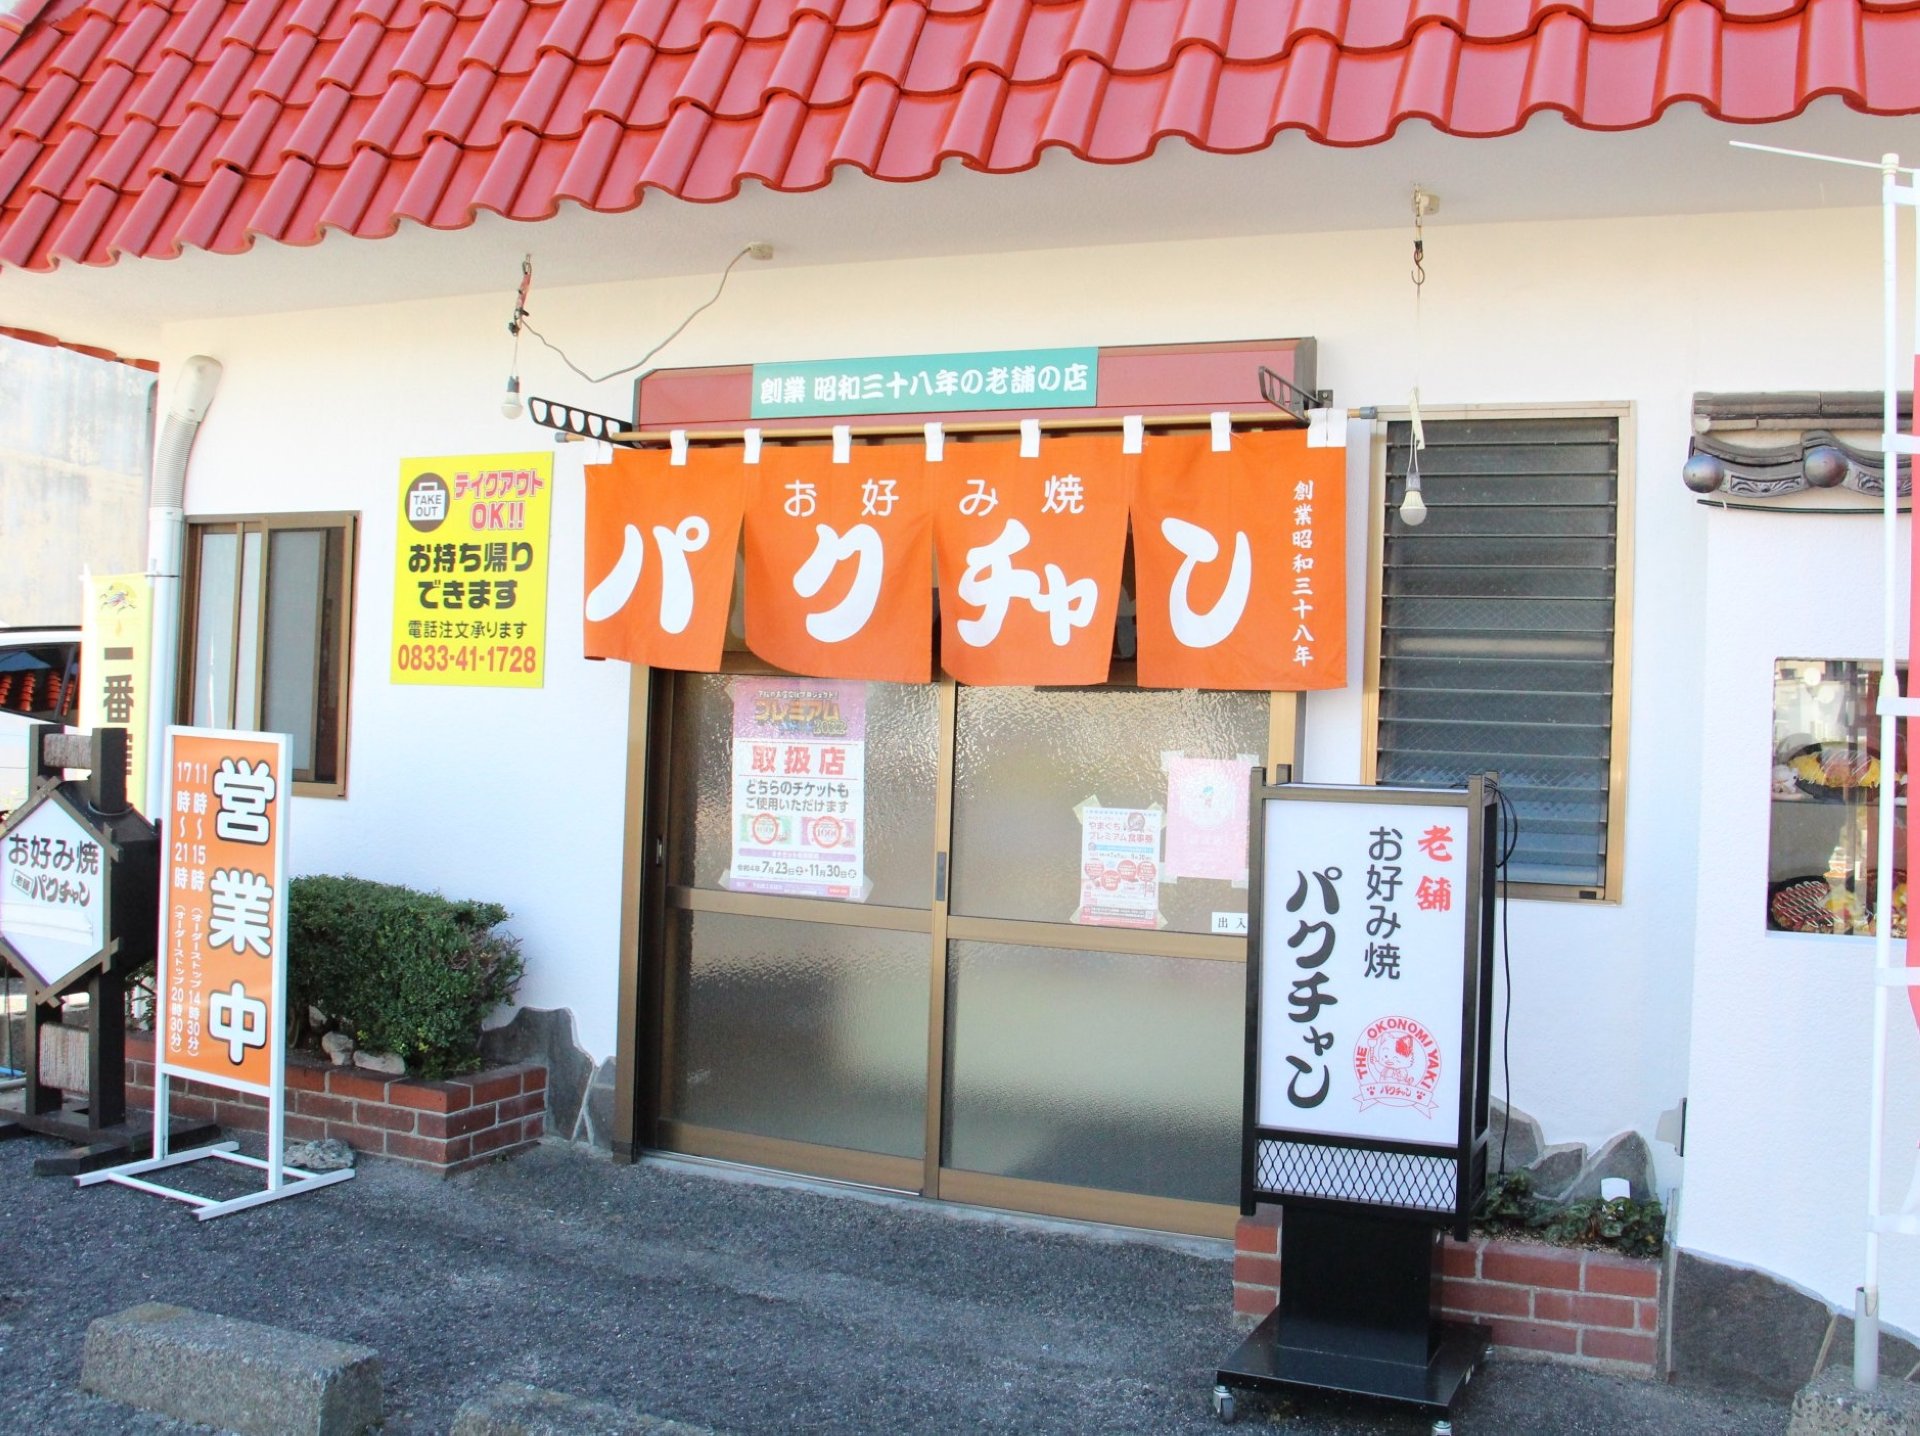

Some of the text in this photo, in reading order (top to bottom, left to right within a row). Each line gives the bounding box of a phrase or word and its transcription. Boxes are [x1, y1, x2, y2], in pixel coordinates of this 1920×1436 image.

[760, 362, 1089, 404] 創業 昭和三十八年の老舗の店
[413, 494, 442, 505] TAKE
[455, 469, 543, 499] テイクアウト
[784, 474, 1085, 517] お好み焼
[415, 506, 439, 517] OUT
[472, 502, 524, 530] OK!!
[408, 541, 534, 573] お持ち帰り
[1292, 480, 1315, 667] 創業昭和三十八年
[417, 579, 518, 609] できます
[585, 516, 1253, 648] パクチャン
[408, 620, 528, 639] 電話注文承ります
[751, 745, 846, 775] 取扱店
[746, 780, 849, 798] どちらのチケットも
[746, 797, 849, 813] ご使用いただけます
[8, 833, 99, 875] お好み焼
[1415, 824, 1453, 912] 老舗
[31, 874, 90, 907] パクチャン
[1364, 826, 1404, 980] お好み焼
[208, 757, 276, 1065] 営業中
[1286, 866, 1342, 1109] パクチャン
[1356, 1018, 1440, 1089] THE OKONOMI YAKI
